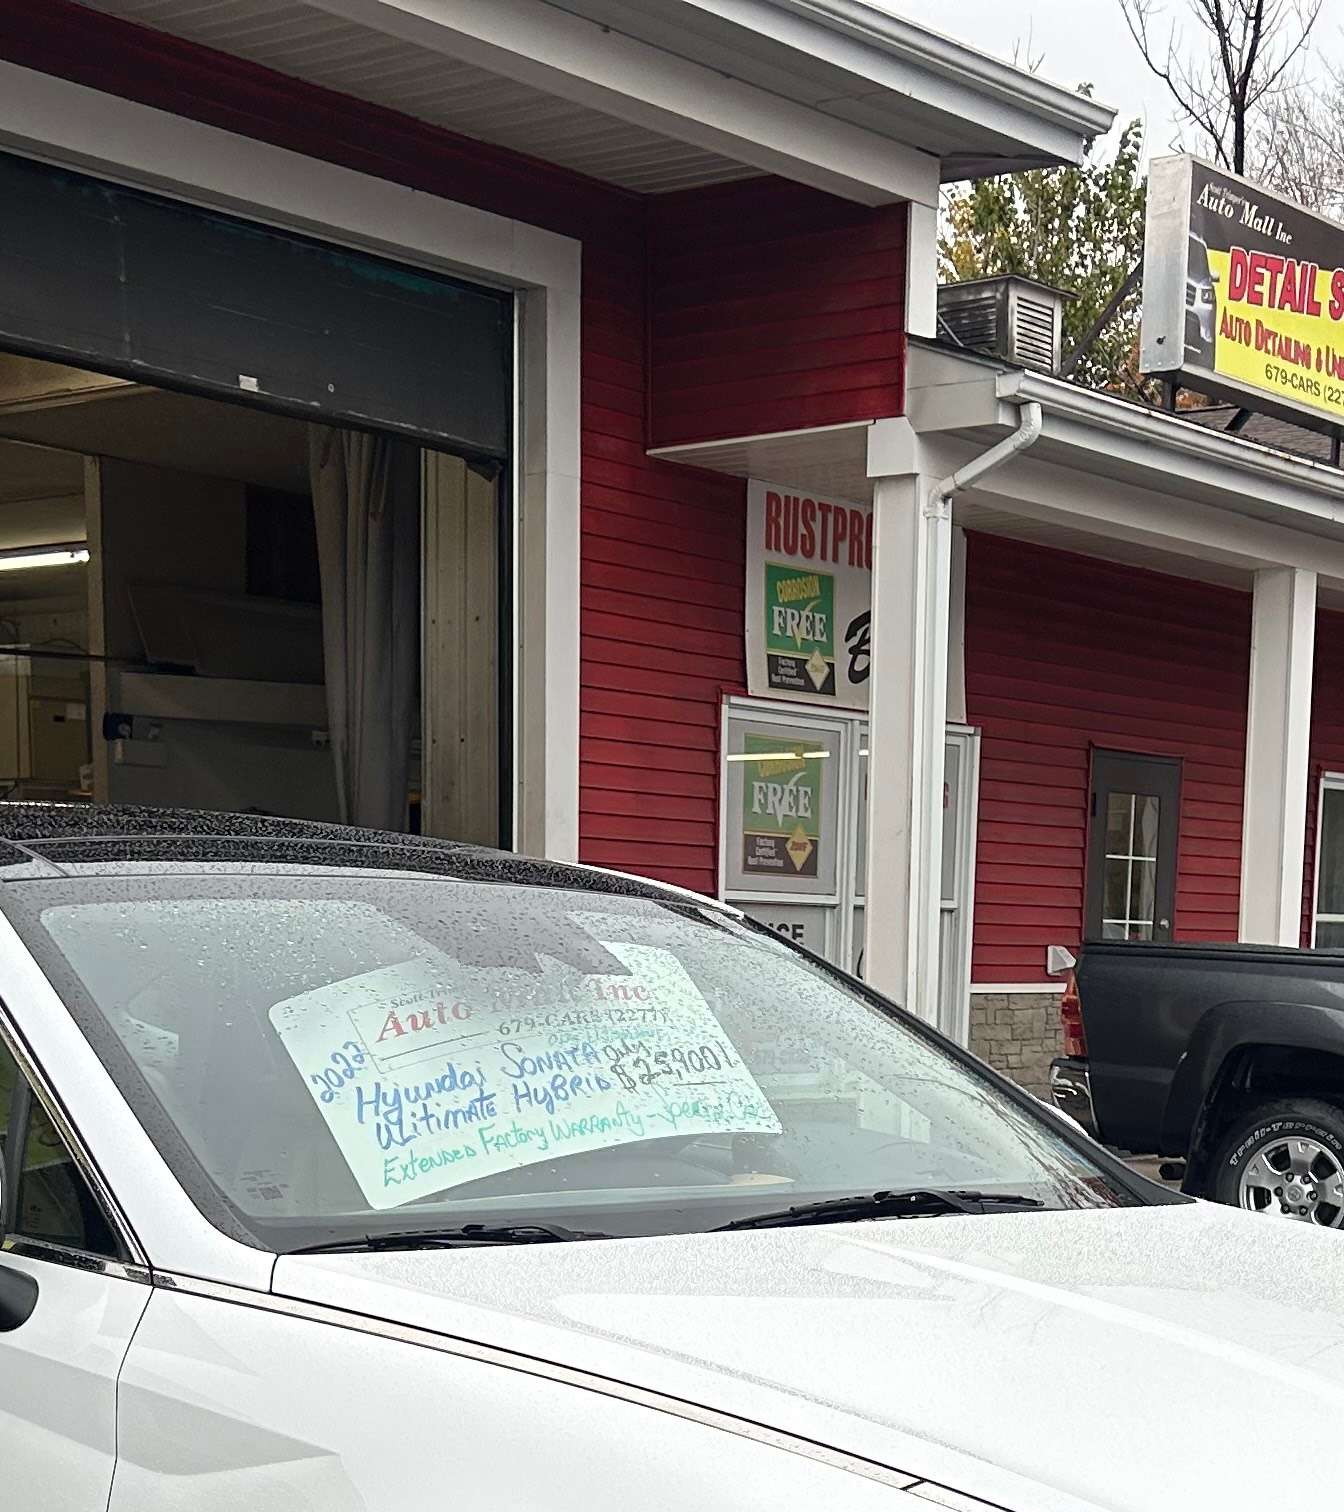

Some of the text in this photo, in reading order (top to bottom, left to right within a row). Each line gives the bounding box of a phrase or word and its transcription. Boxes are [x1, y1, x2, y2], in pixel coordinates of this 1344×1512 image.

[1197, 183, 1234, 218] Auto
[1239, 201, 1275, 236] Mall
[1276, 222, 1293, 244] Inc
[1228, 247, 1321, 317] DETAIL
[1264, 363, 1321, 397] 679-CARS
[772, 605, 827, 643] FREE
[751, 780, 812, 819] FREE
[376, 1001, 473, 1043] Auto
[309, 1040, 367, 1104] 2022
[355, 1061, 487, 1126] Hyundai
